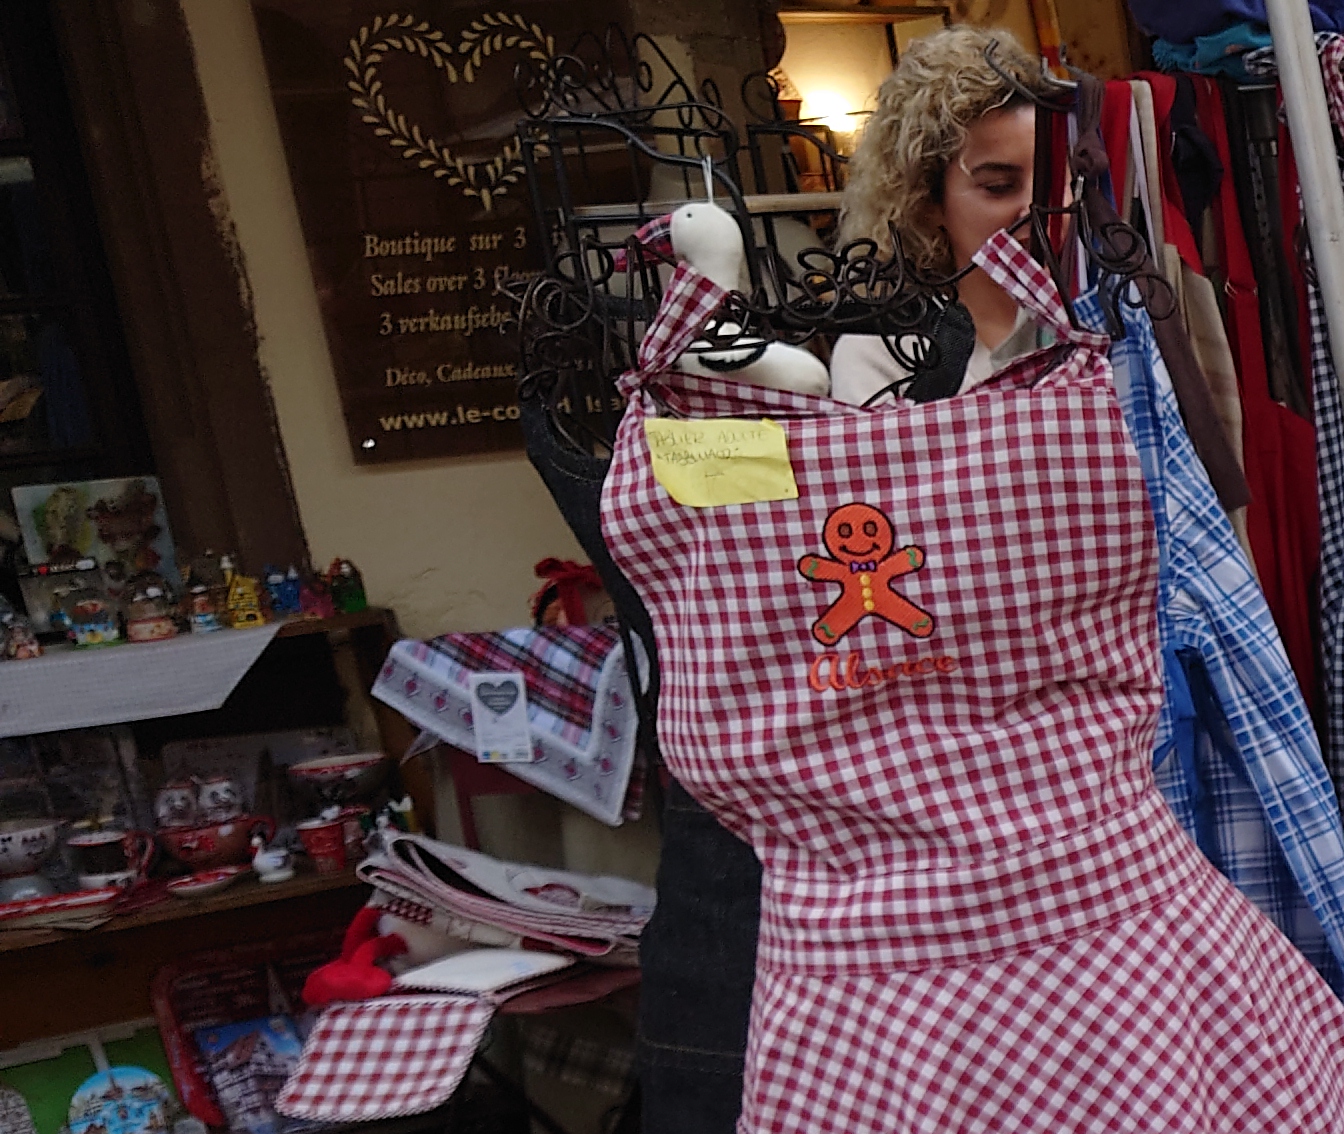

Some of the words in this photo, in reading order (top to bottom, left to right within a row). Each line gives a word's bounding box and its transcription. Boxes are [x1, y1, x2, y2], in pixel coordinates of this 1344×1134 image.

[363, 230, 456, 262] Boutique
[468, 232, 504, 252] sur
[514, 226, 528, 251] 3
[370, 271, 421, 298] Sales
[426, 272, 469, 293] over
[473, 265, 487, 291] 3
[380, 311, 394, 336] 3
[806, 651, 961, 695] Alsace
